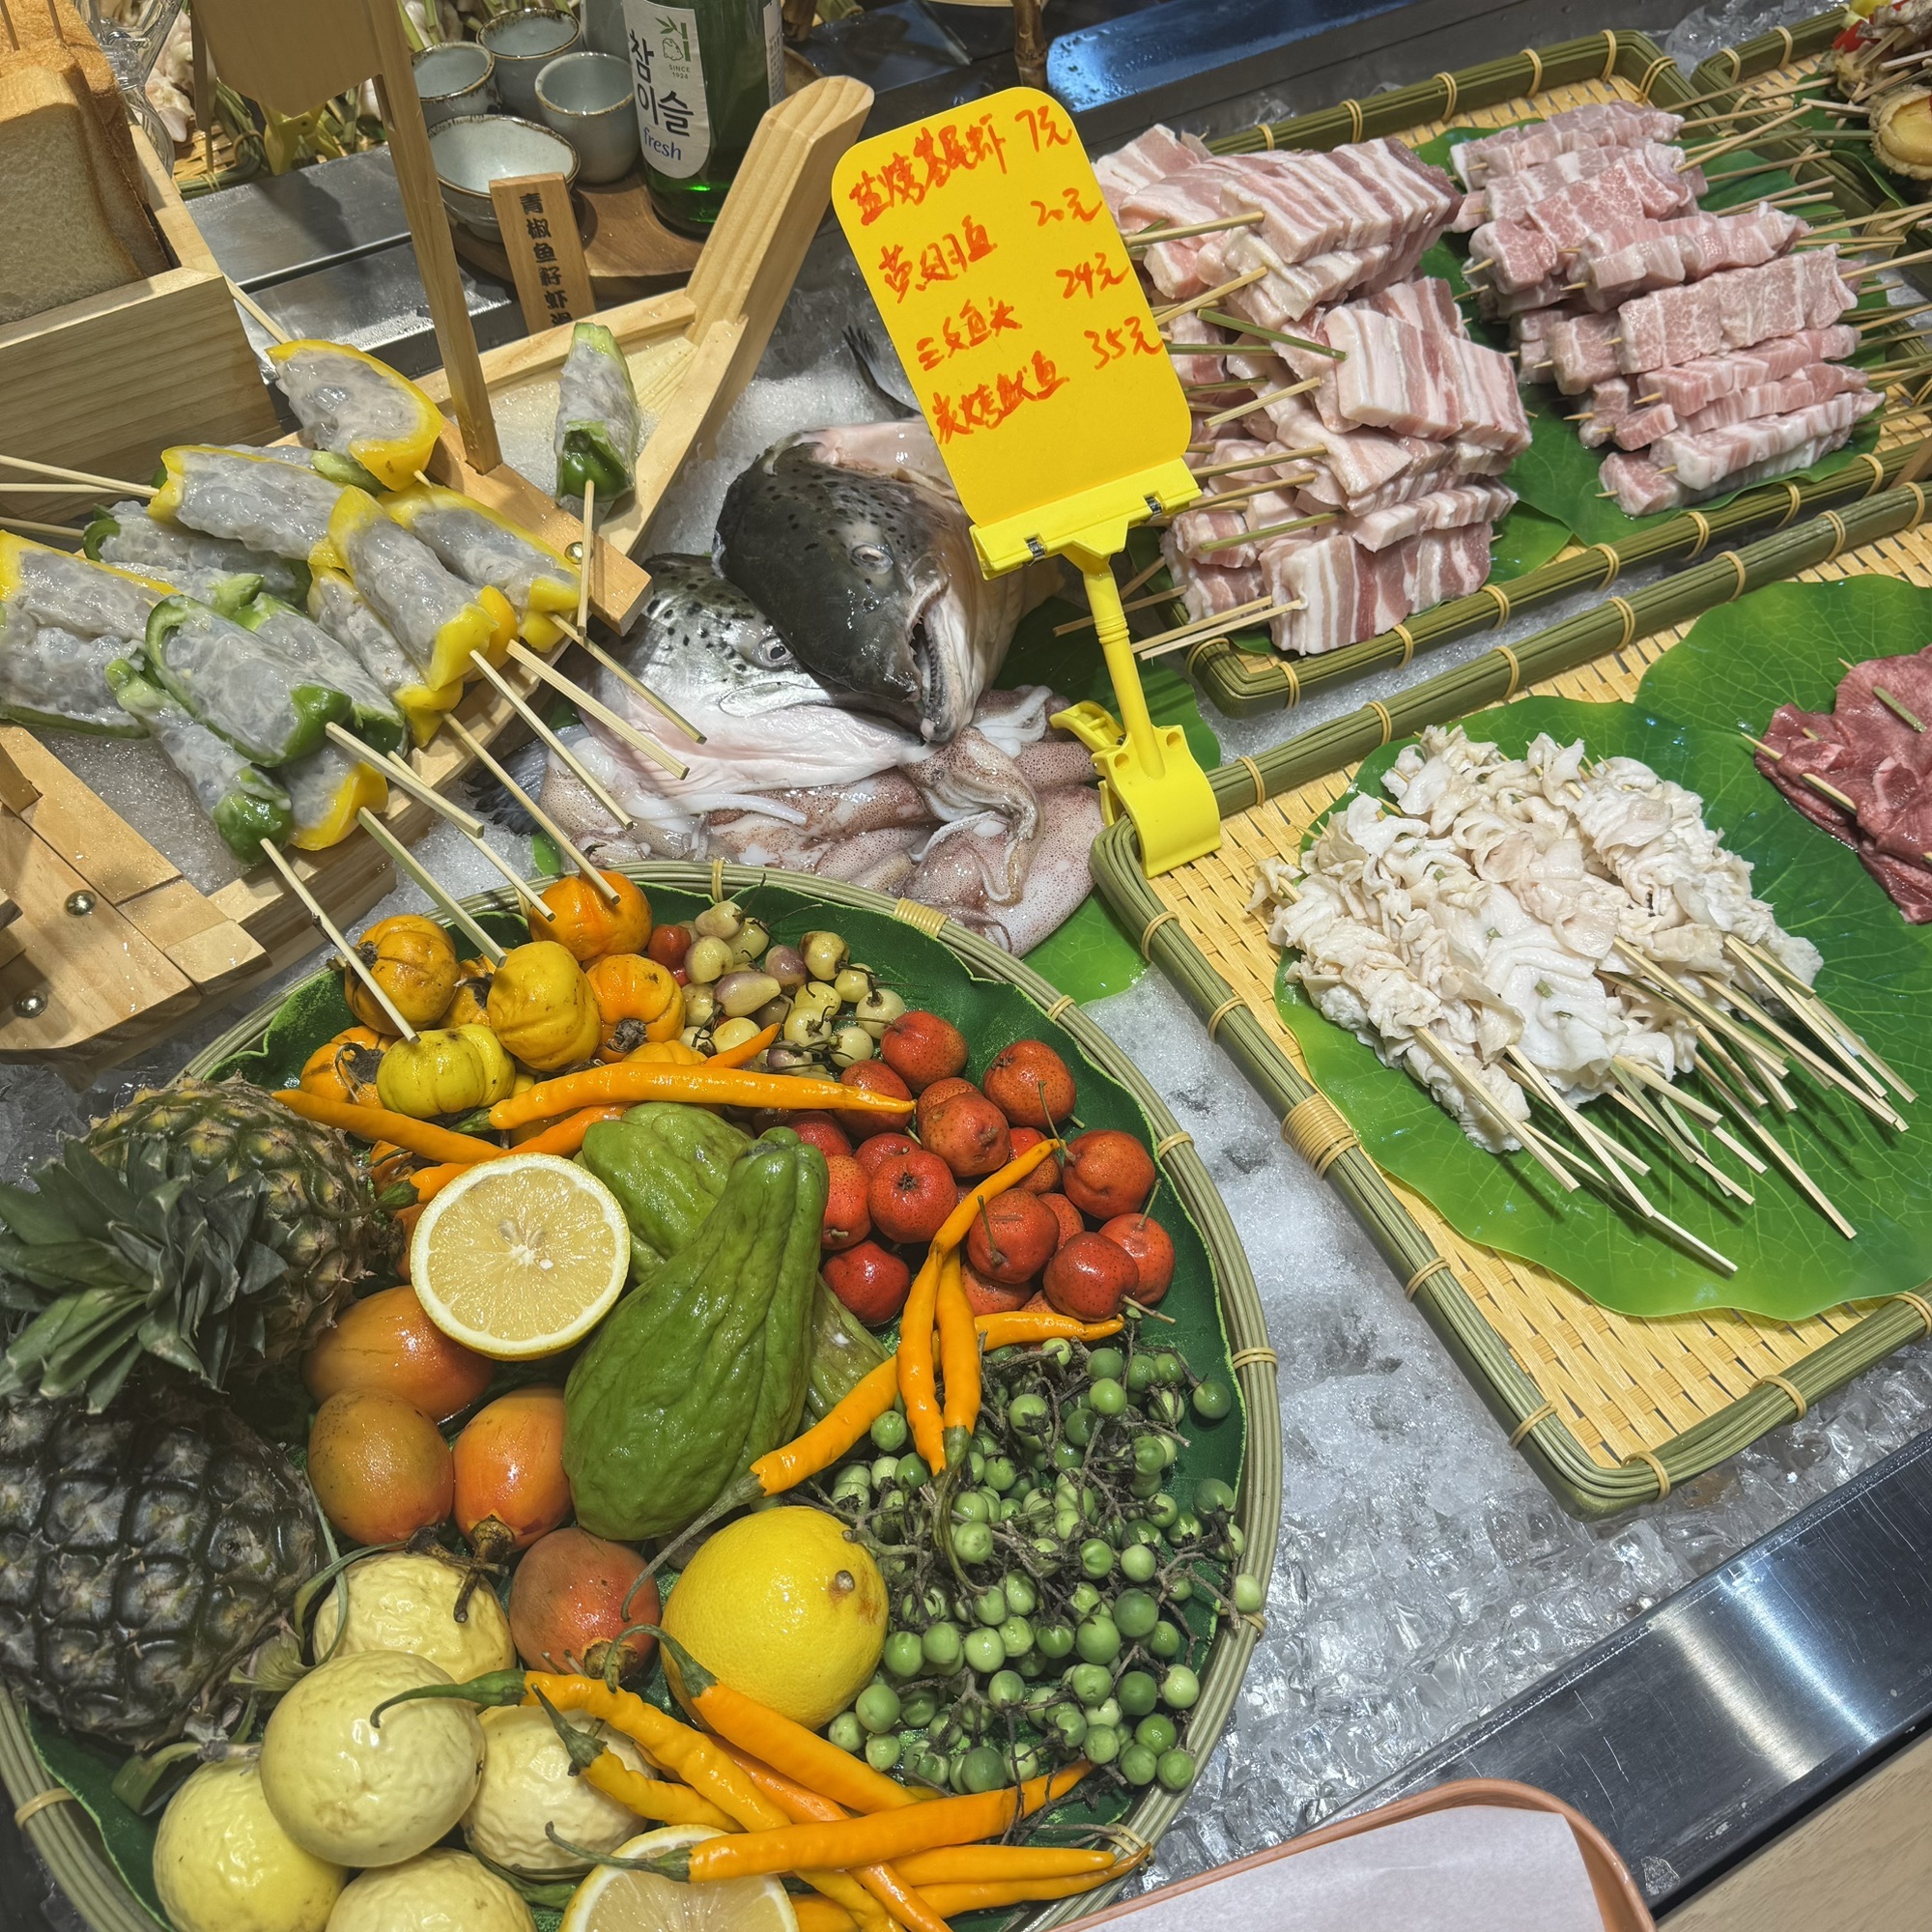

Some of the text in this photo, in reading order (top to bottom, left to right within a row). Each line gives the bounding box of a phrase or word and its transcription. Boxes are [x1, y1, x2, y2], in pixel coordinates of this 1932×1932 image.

[629, 29, 695, 137] 참이슬
[668, 64, 692, 73] SINCE
[672, 71, 690, 80] 1924
[642, 127, 682, 161] fresh
[1014, 105, 1072, 152] 7元
[1030, 187, 1102, 227] 20元
[916, 252, 1129, 371] 三文鱼头 24元
[1083, 316, 1164, 370] 35元
